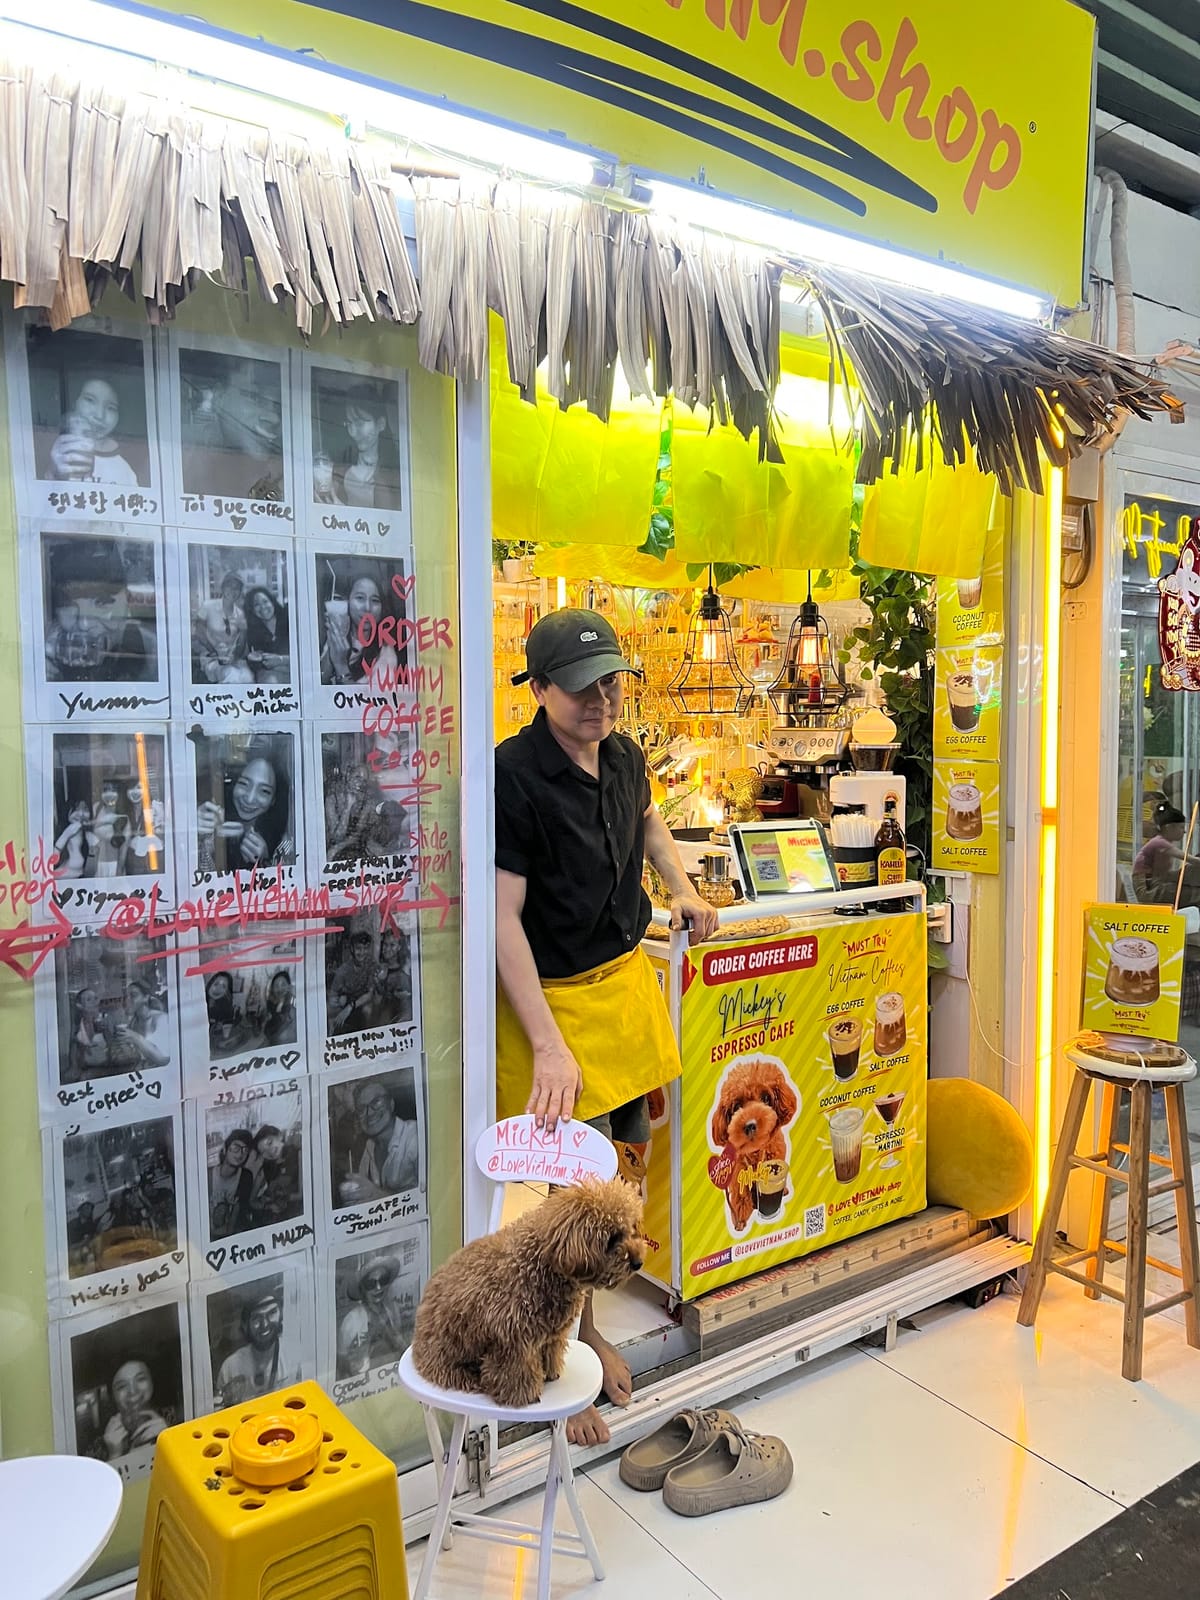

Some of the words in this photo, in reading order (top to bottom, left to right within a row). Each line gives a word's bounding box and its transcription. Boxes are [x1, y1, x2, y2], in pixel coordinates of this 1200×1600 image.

[952, 611, 985, 624] COCONUT
[956, 619, 983, 632] COFFEE
[357, 613, 454, 651] ORDER
[945, 736, 959, 745] EGG
[960, 735, 987, 745] COFFEE
[941, 846, 958, 856] SALT
[960, 847, 988, 857] COFFEE
[1103, 921, 1129, 932] SALT
[1131, 923, 1171, 935] COFFEE
[847, 937, 871, 957] MUST
[709, 954, 746, 977] ORDER
[748, 947, 786, 970] COFFEE
[787, 943, 814, 963] HERE
[826, 1003, 840, 1014] EGG
[841, 998, 865, 1012] COFFEE
[710, 1030, 765, 1063] ESPRESSO
[769, 1020, 795, 1043] CAFE
[868, 1060, 886, 1073] SALT
[886, 1054, 910, 1068] COFFEE
[818, 1091, 852, 1107] COCONUT
[852, 1084, 877, 1099] COFFEE
[874, 1127, 906, 1144] ESPRESSO
[877, 1138, 903, 1153] MARTINI
[835, 1198, 852, 1213] LOVE
[734, 1226, 800, 1258] @LOVEVIETNAM.SHOP
[696, 1255, 721, 1271] FOLLOW
[721, 1252, 731, 1262] ME
